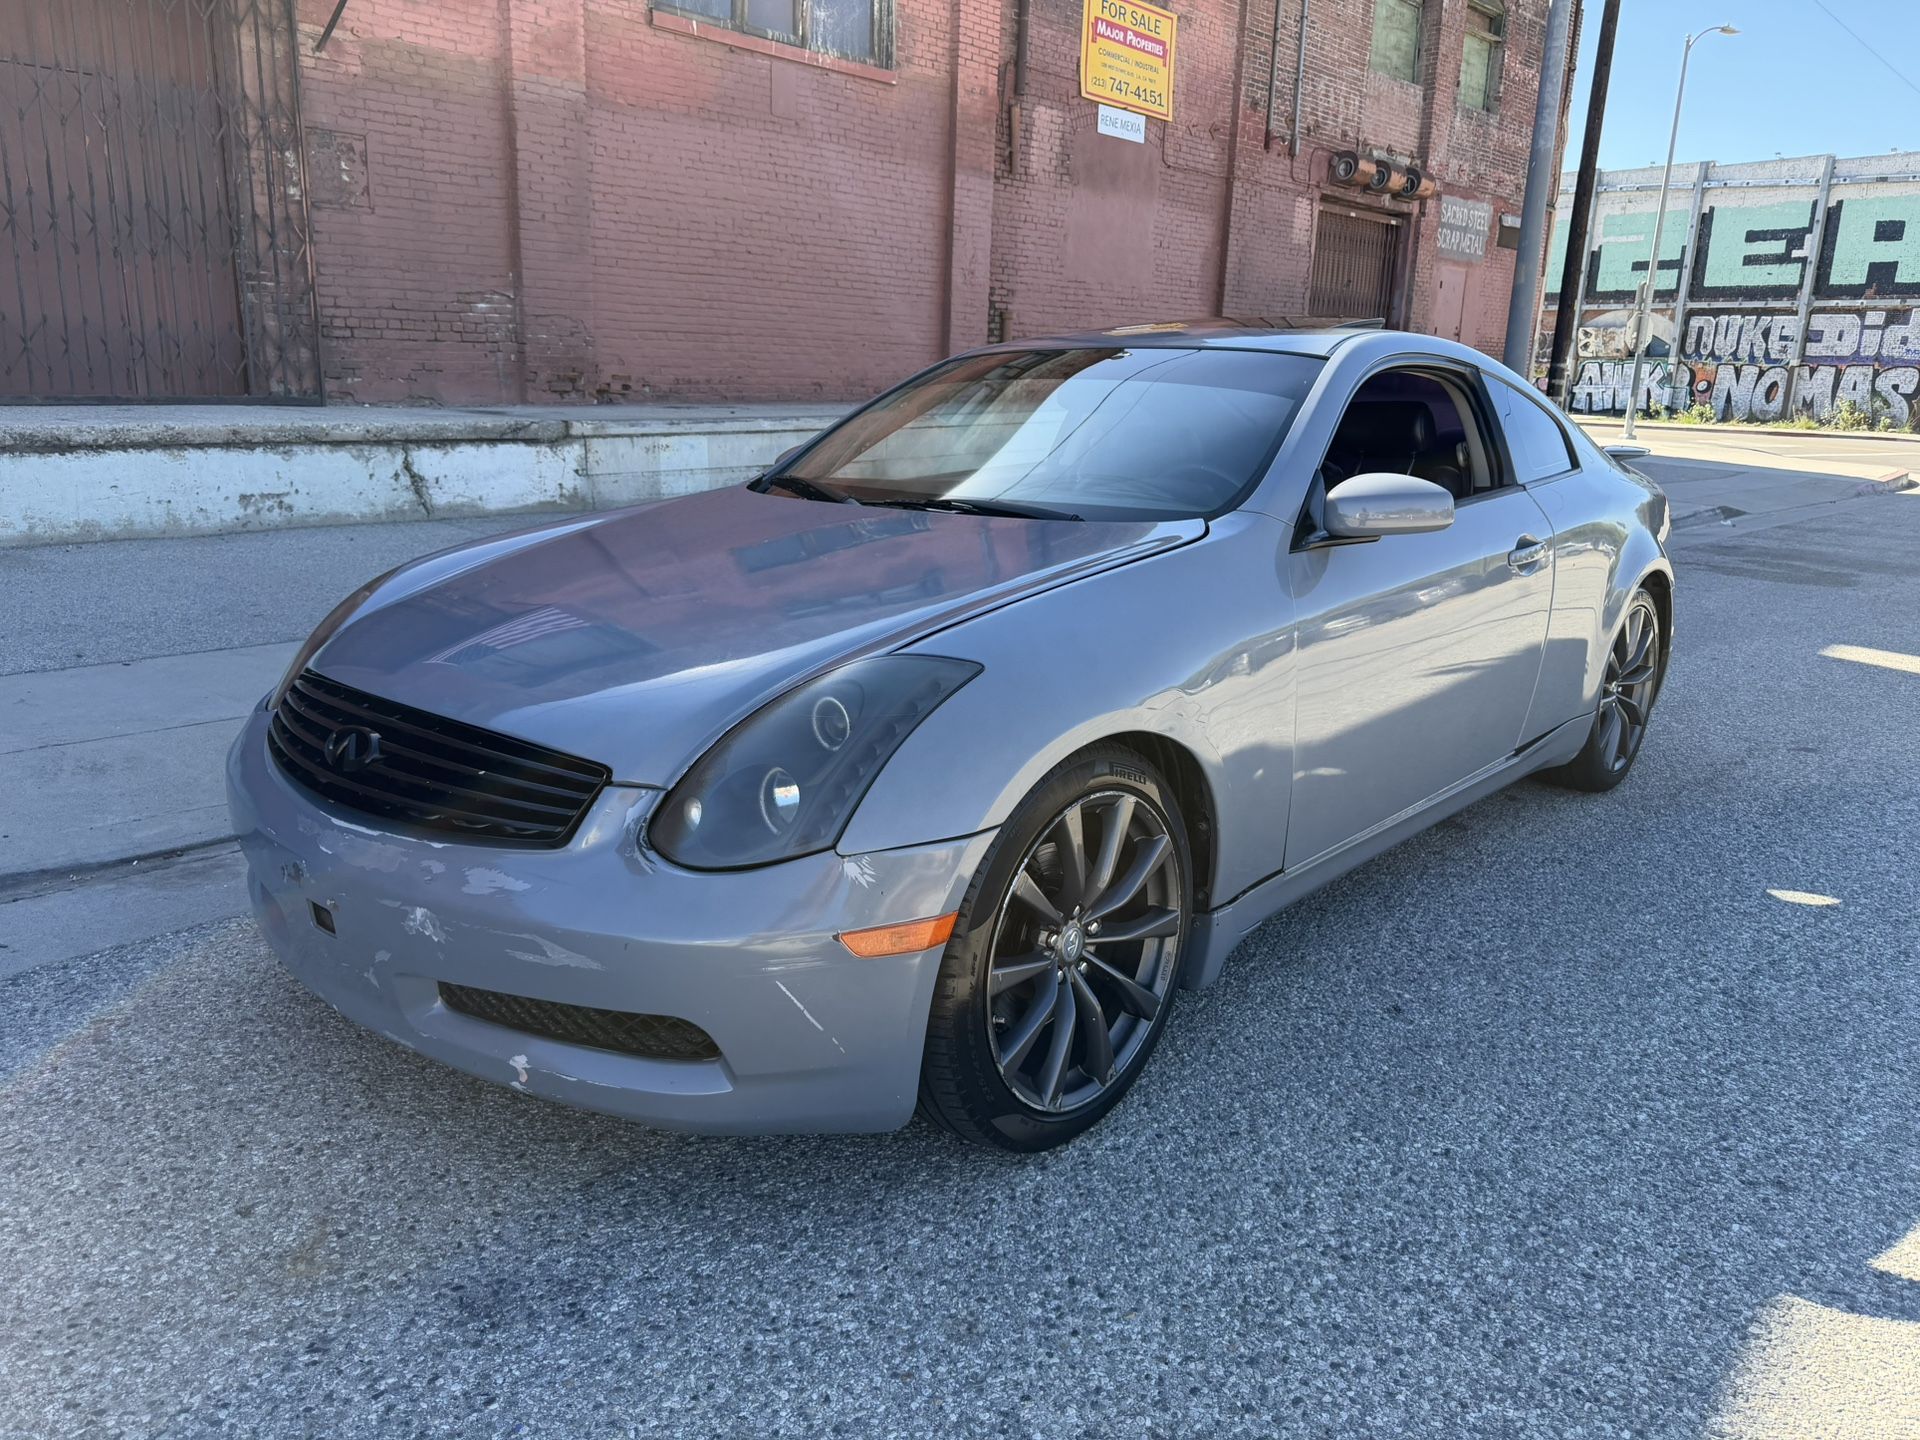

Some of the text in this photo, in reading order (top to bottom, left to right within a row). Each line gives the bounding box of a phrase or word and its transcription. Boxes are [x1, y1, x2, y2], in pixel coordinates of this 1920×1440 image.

[1101, 0, 1162, 35] FOR SALE
[1098, 47, 1130, 65] COMMERCIAL
[1134, 61, 1160, 75] INDUSTRIAL
[1091, 76, 1164, 107] (213) 747-4151
[1100, 114, 1142, 134] RENE MEXIA
[1441, 203, 1489, 231] SACRED STEEL
[1437, 228, 1483, 255] SCRAP METAL
[1108, 761, 1147, 785] PIRELLI
